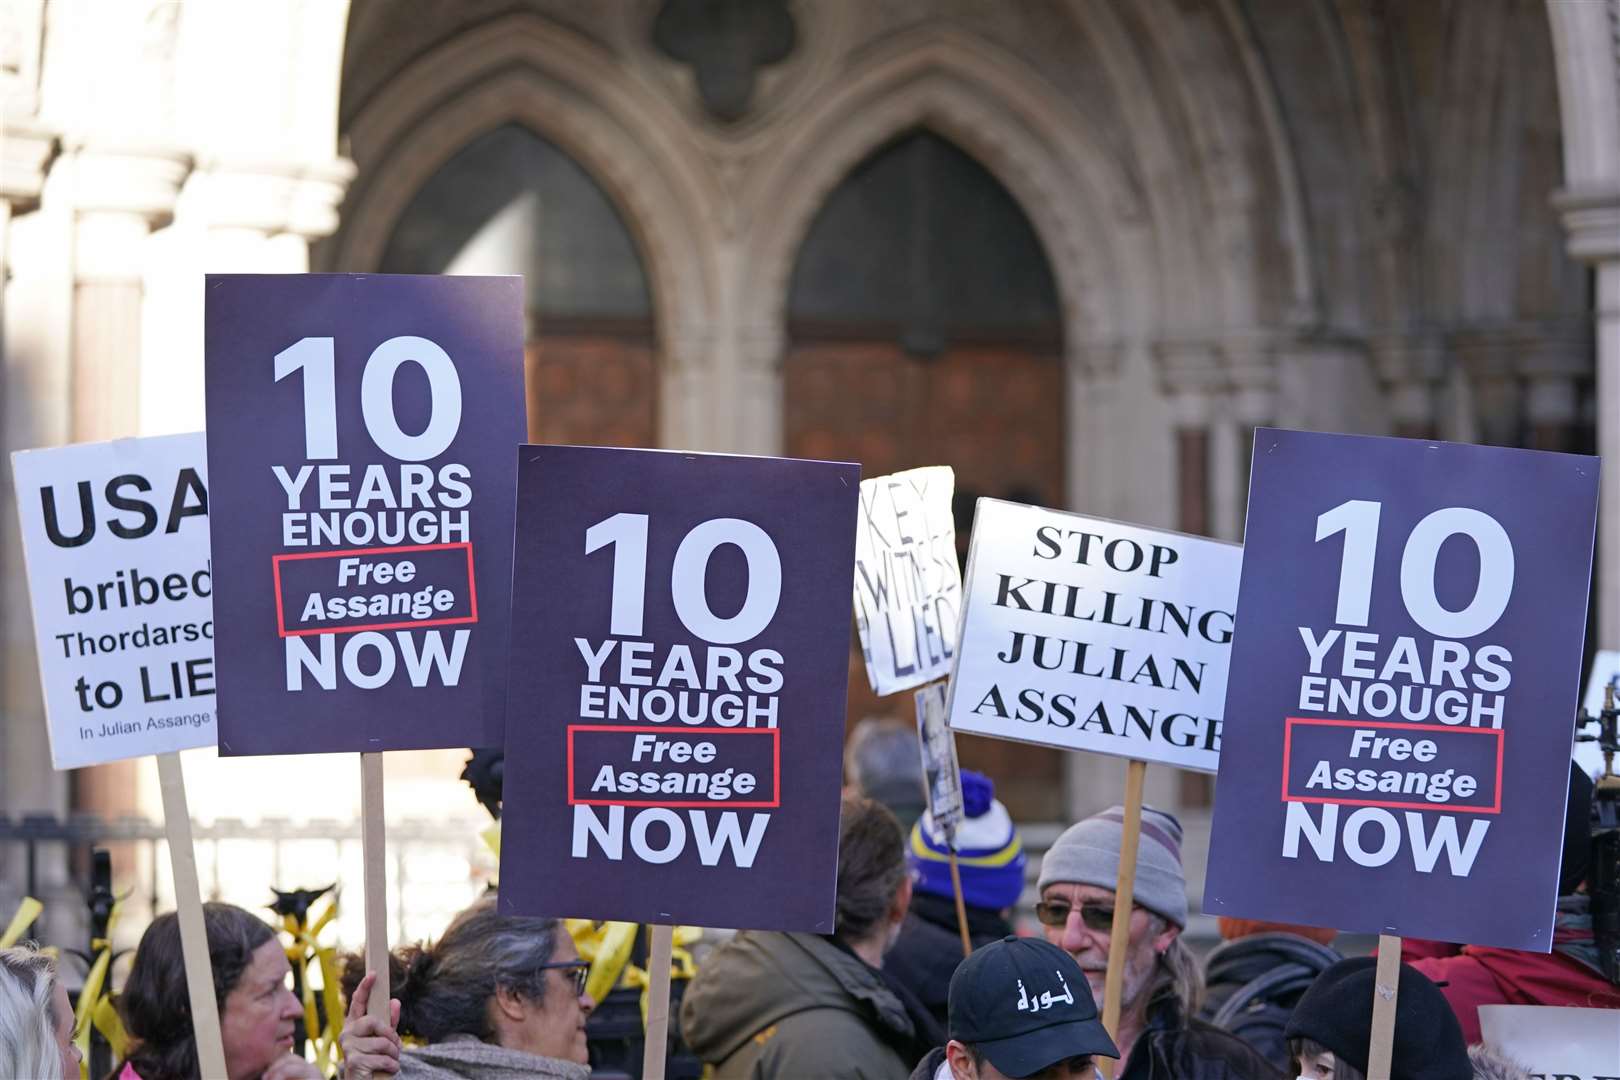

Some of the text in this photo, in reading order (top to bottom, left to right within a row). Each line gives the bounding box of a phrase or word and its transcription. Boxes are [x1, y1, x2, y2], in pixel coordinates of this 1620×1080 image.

[274, 335, 462, 462] 10
[40, 467, 208, 548] USA
[272, 463, 473, 511] YEARS
[282, 510, 471, 546] ENOUGH
[1033, 525, 1179, 578] STOP
[338, 557, 417, 587] Free
[585, 512, 782, 645] 10
[1314, 499, 1515, 639] 10
[300, 584, 456, 622] Assange
[991, 573, 1234, 644] KILLING
[75, 657, 216, 712] to LIE
[285, 629, 471, 691] NOW
[574, 637, 784, 694] YEARS
[997, 631, 1208, 695] JULIAN
[1298, 626, 1513, 692] YEARS
[79, 726, 94, 740] In
[98, 720, 141, 738] Julian
[146, 711, 211, 733] Assange
[580, 684, 779, 729] ENOUGH
[1298, 675, 1505, 730] ENOUGH
[631, 734, 717, 763] Free
[1349, 729, 1438, 762] Free
[590, 765, 757, 800] Assange
[1305, 760, 1478, 803] Assange
[571, 803, 771, 868] NOW
[1282, 800, 1491, 877] NOW
